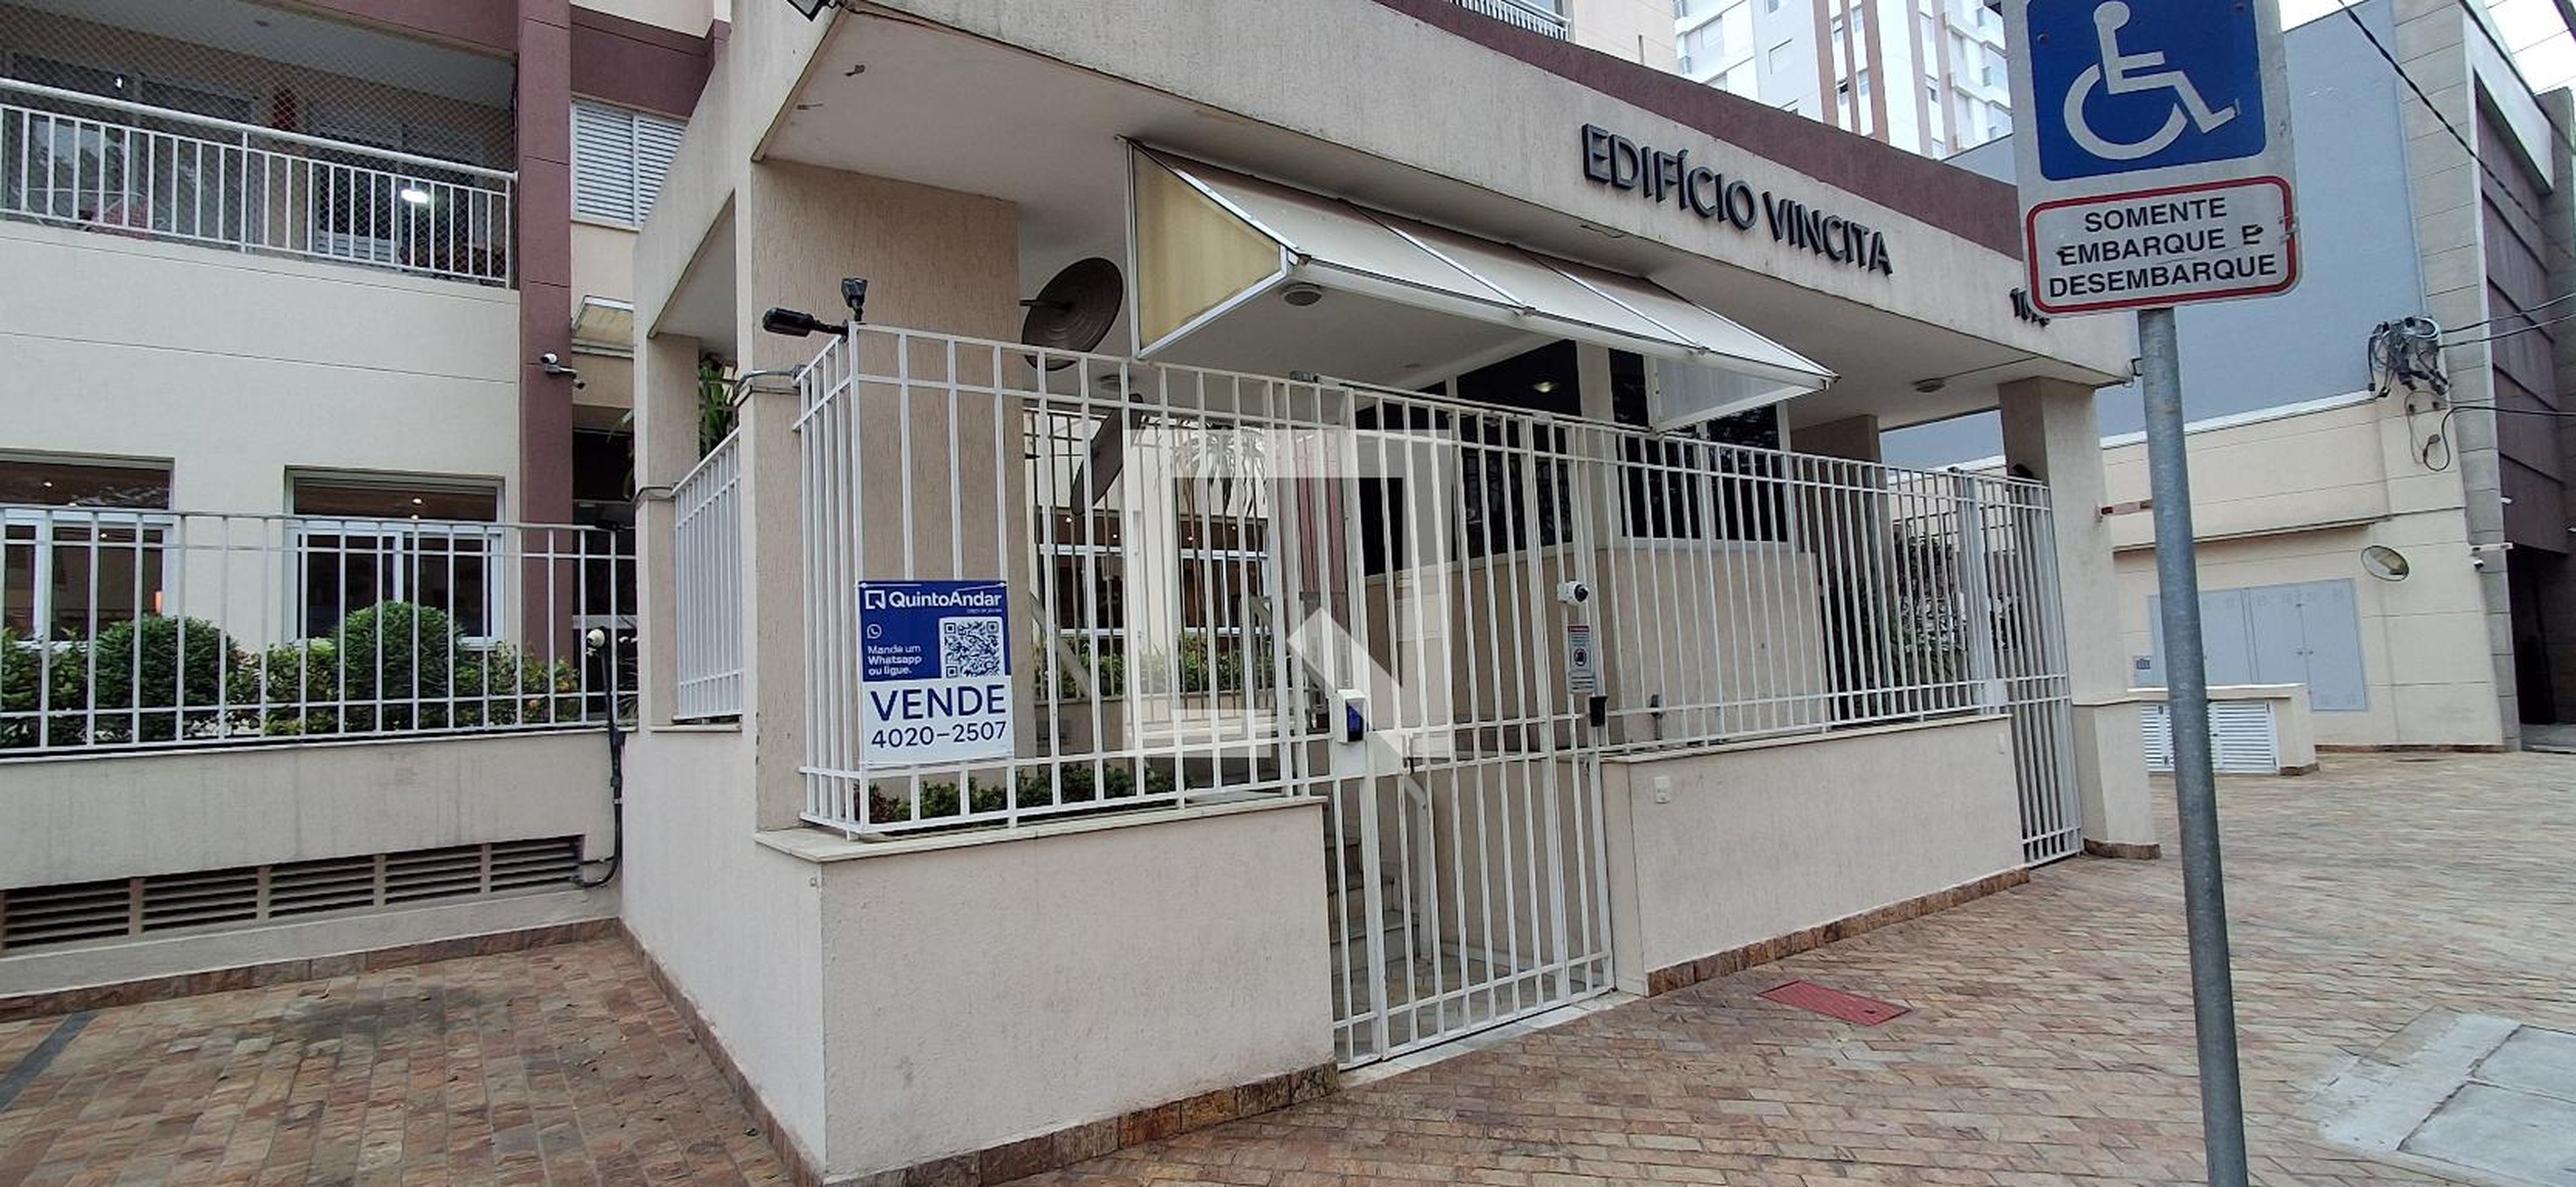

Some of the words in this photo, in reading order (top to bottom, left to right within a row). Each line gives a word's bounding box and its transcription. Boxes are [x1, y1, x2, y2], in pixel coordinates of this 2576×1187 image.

[1582, 123, 1758, 230] EDIFÍCIO
[1762, 191, 1893, 275] VINCITA
[2085, 198, 2226, 232] SOMENTE
[2059, 229, 2225, 266] EMBARQUE
[2243, 225, 2263, 245] E
[2050, 254, 2277, 298] DESEMBARQUE
[889, 591, 1002, 608] QuintoAndar
[867, 644, 903, 655] Mande
[905, 645, 921, 653] um
[867, 656, 922, 665] Whatsapp
[869, 668, 882, 676] ou
[883, 666, 912, 677] ligue.
[871, 685, 1006, 722] VENDE
[871, 721, 1007, 748] 4020-2507
